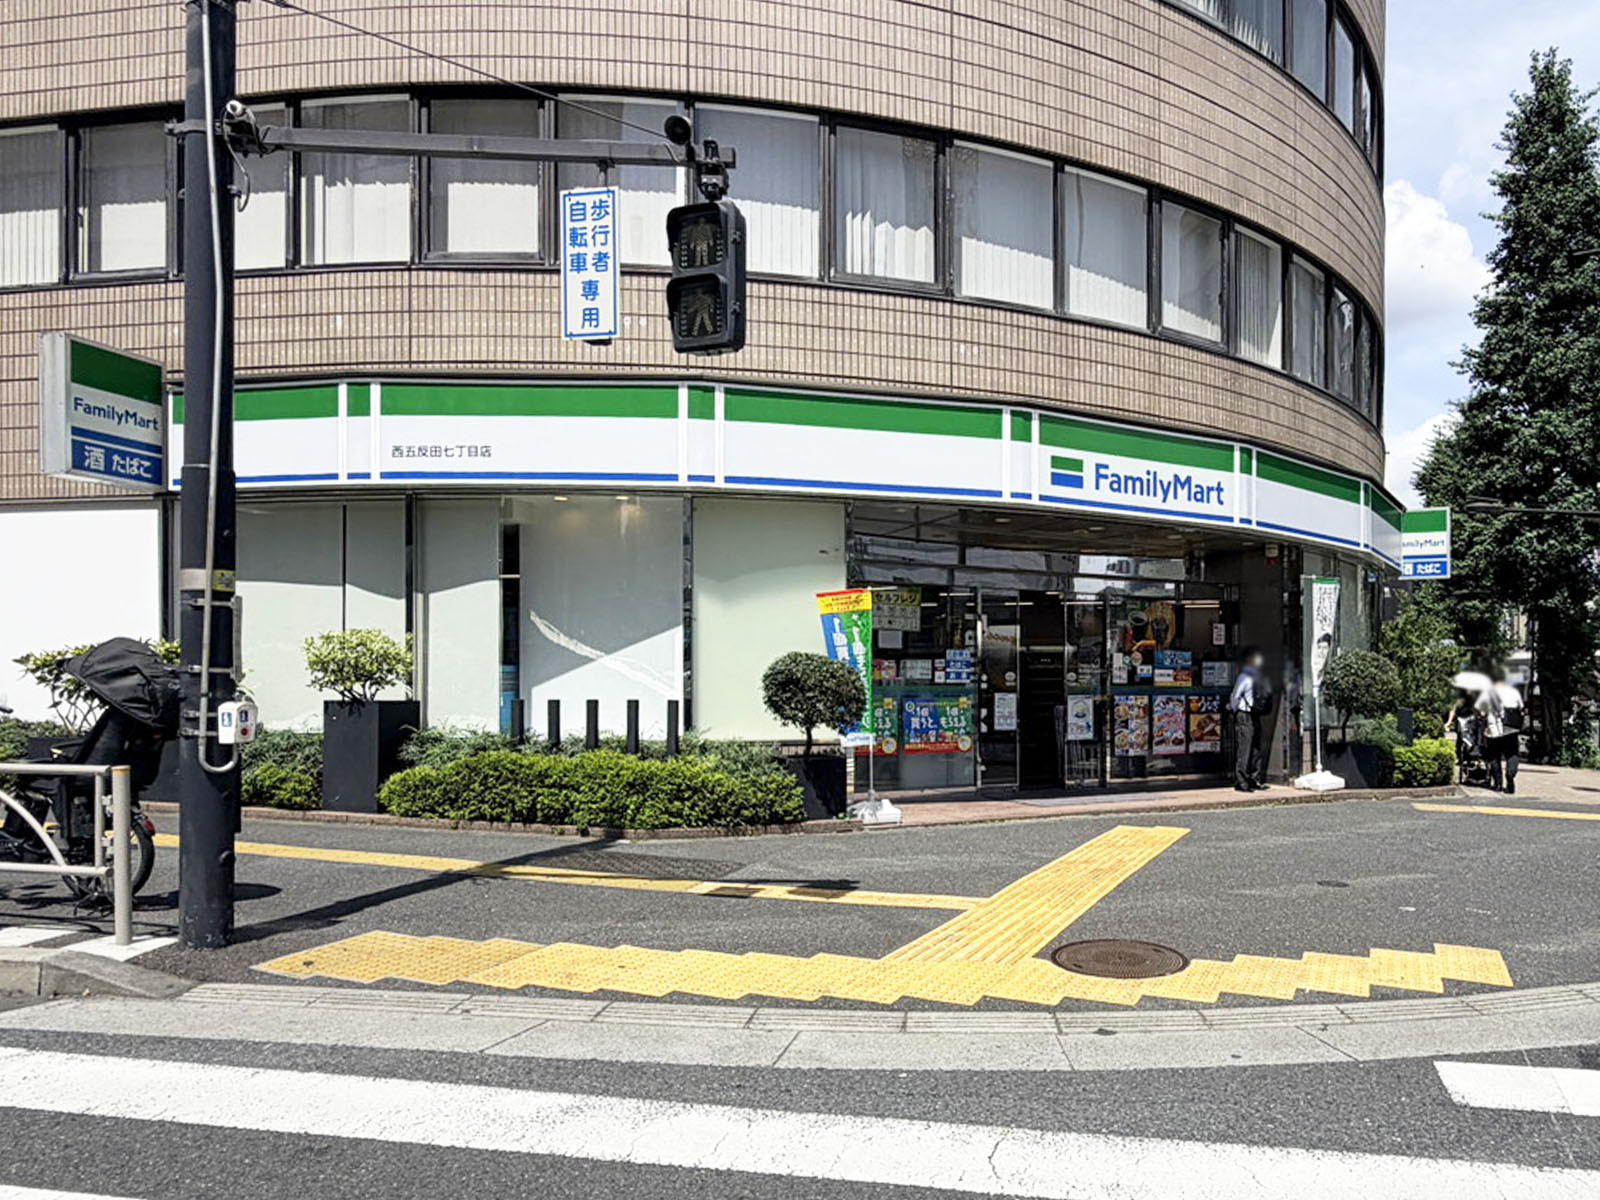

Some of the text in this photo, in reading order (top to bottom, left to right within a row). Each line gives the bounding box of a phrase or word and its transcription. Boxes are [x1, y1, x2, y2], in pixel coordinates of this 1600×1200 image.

[569, 201, 588, 274] 自転車
[591, 199, 610, 273] 歩行者
[581, 279, 600, 329] 専用
[74, 397, 159, 430] FamilyMart
[84, 445, 152, 478] 酒 たばこ
[391, 445, 492, 458] 西五反田七丁目店
[1095, 463, 1224, 505] FamilyMart
[1416, 563, 1441, 574] たばこ
